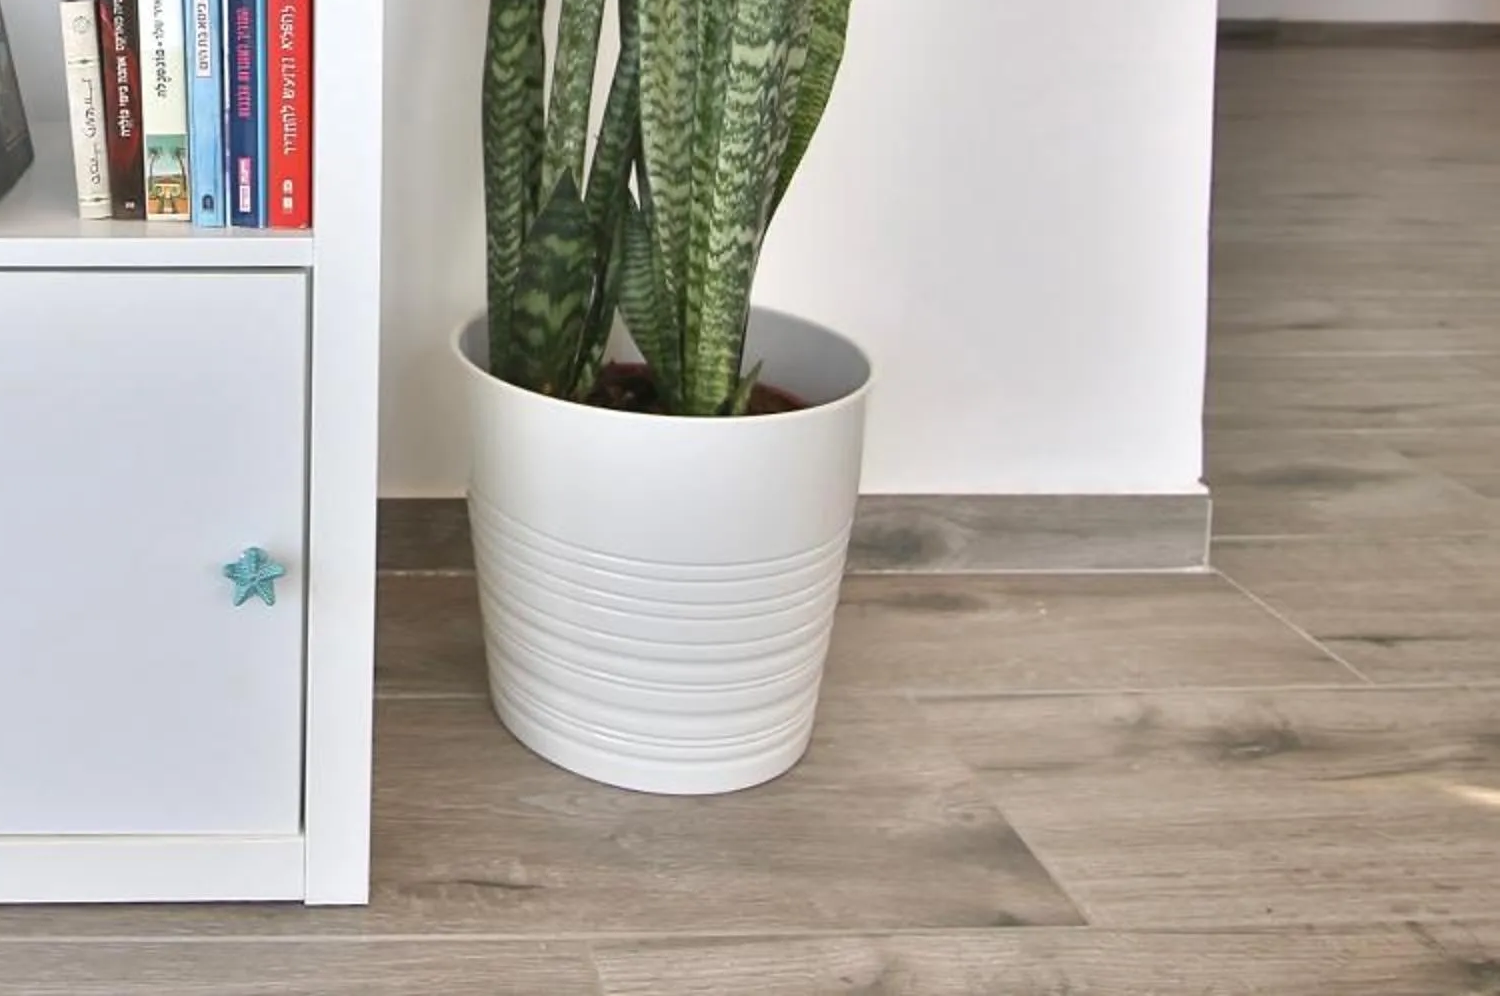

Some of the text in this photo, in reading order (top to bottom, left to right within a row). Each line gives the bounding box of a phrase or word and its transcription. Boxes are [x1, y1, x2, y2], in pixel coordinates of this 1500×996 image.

[278, 4, 296, 50] להפליא
[280, 56, 295, 99] ורועש
[280, 104, 297, 155] להחריד
